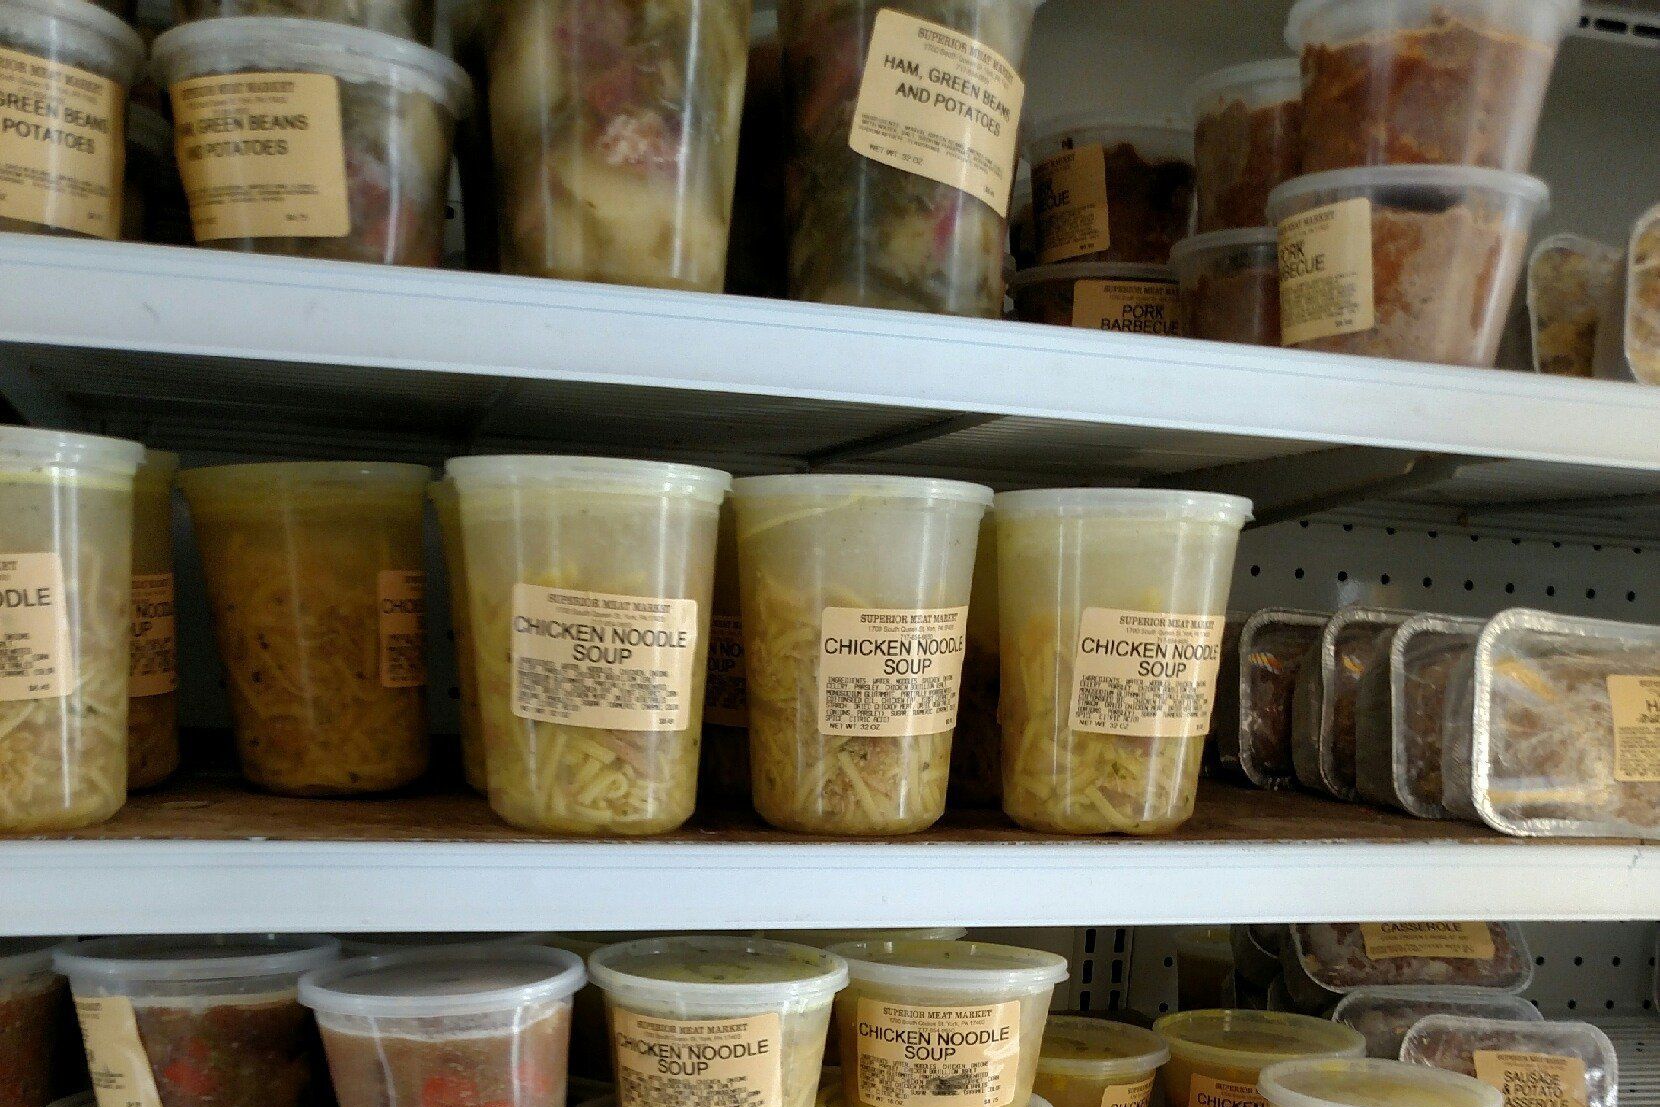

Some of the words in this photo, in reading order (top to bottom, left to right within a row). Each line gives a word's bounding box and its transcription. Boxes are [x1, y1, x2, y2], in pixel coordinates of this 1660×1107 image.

[884, 54, 923, 80] HAM,
[928, 67, 981, 99] GREEN
[895, 82, 931, 104] AND
[933, 93, 1001, 137] POTATOES
[1122, 304, 1164, 318] PORK
[860, 614, 909, 624] SUPERIOR
[910, 614, 933, 624] MEAT
[1119, 615, 1166, 628] SUPERIOR
[1167, 618, 1190, 629] MEAT
[514, 615, 605, 643] CHICKEN
[611, 627, 688, 649] NOODLE
[573, 643, 633, 665] SOUP
[824, 637, 912, 657] CHICKEN
[916, 635, 964, 656] NOODLE
[1081, 637, 1168, 660] CHICKEN
[883, 658, 933, 675] SOUP
[1137, 660, 1187, 678] SOUP
[883, 1006, 925, 1019] SUPERIOR
[927, 1010, 953, 1019] MEAT
[955, 1009, 993, 1019] MARKET
[679, 1025, 704, 1035] MEAT
[707, 1022, 749, 1035] MARKET
[859, 1022, 932, 1046] CHICKEN
[937, 1026, 1010, 1046] NOODLE
[616, 1032, 682, 1061] CHICKEN
[687, 1038, 770, 1061] NOODLE
[904, 1046, 957, 1061] SOUP
[657, 1058, 709, 1076] SOUP
[1514, 1083, 1564, 1099] POTATO
